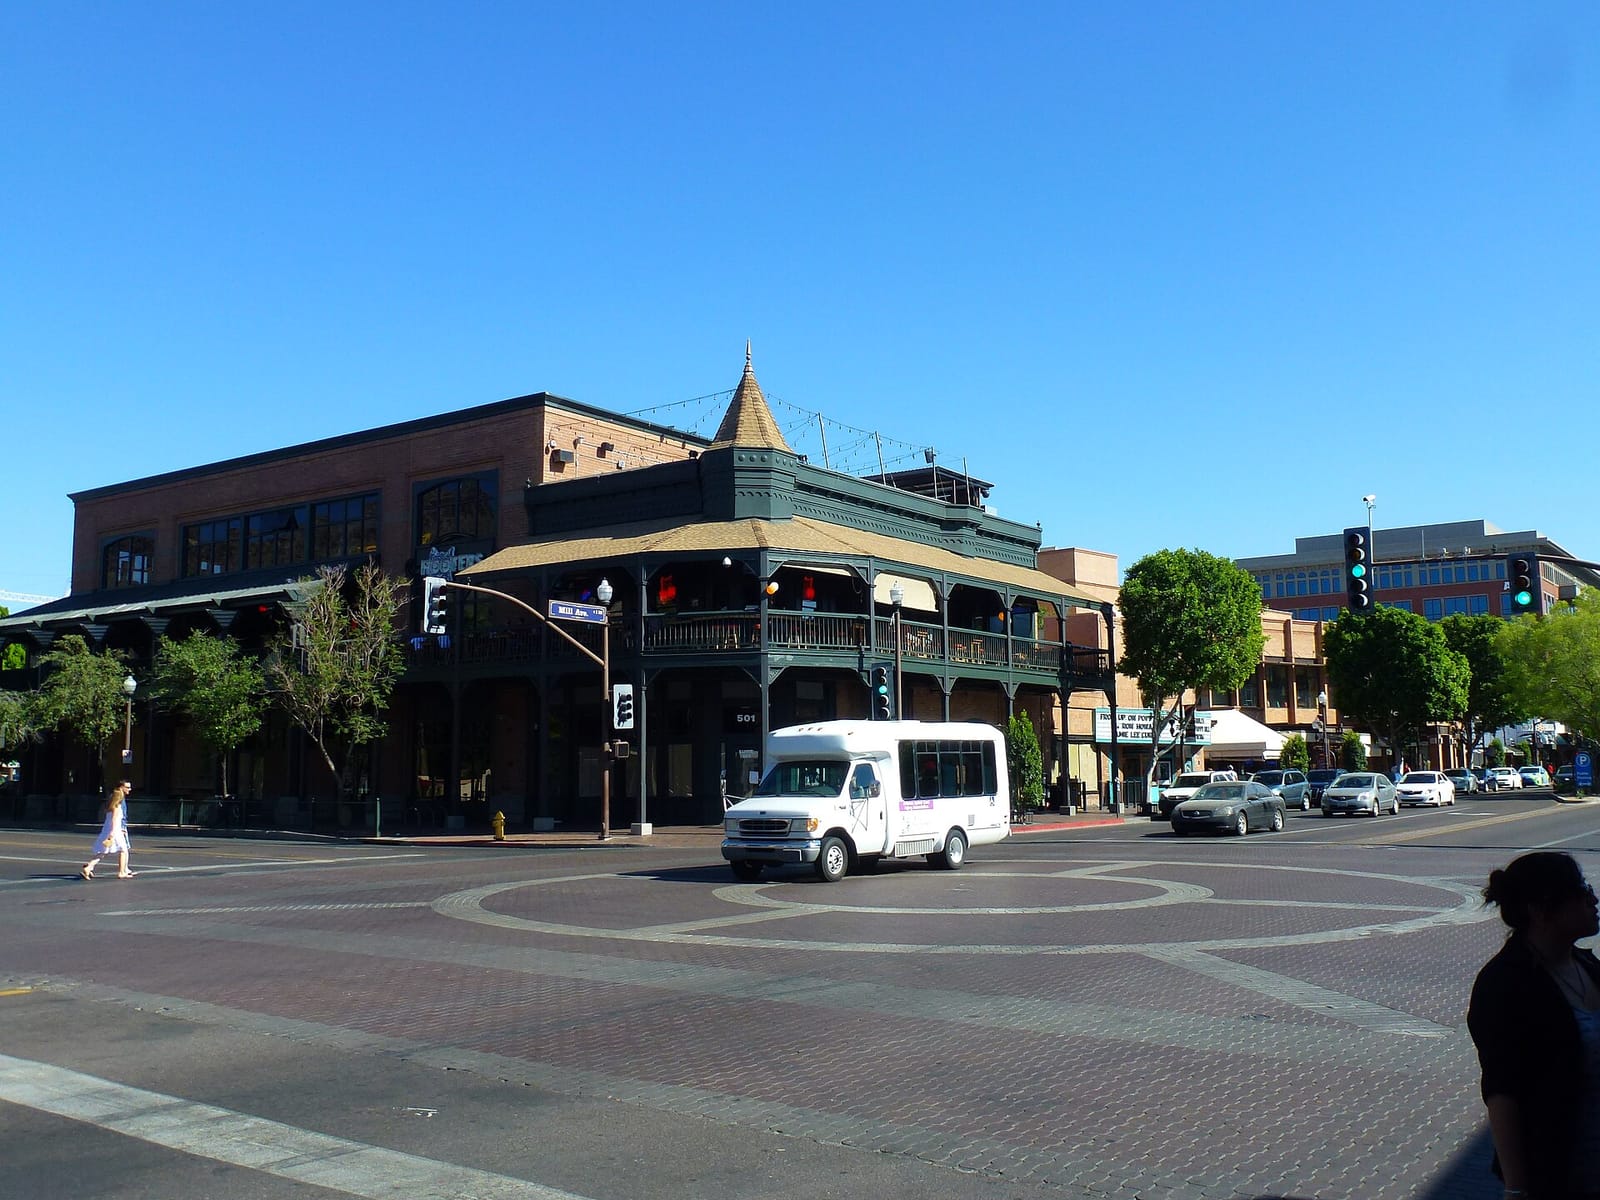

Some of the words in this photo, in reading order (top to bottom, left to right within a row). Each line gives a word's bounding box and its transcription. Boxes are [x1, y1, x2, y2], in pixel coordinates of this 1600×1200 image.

[736, 714, 756, 722] 501
[1099, 713, 1112, 721] FRO
[1580, 755, 1587, 765] P
